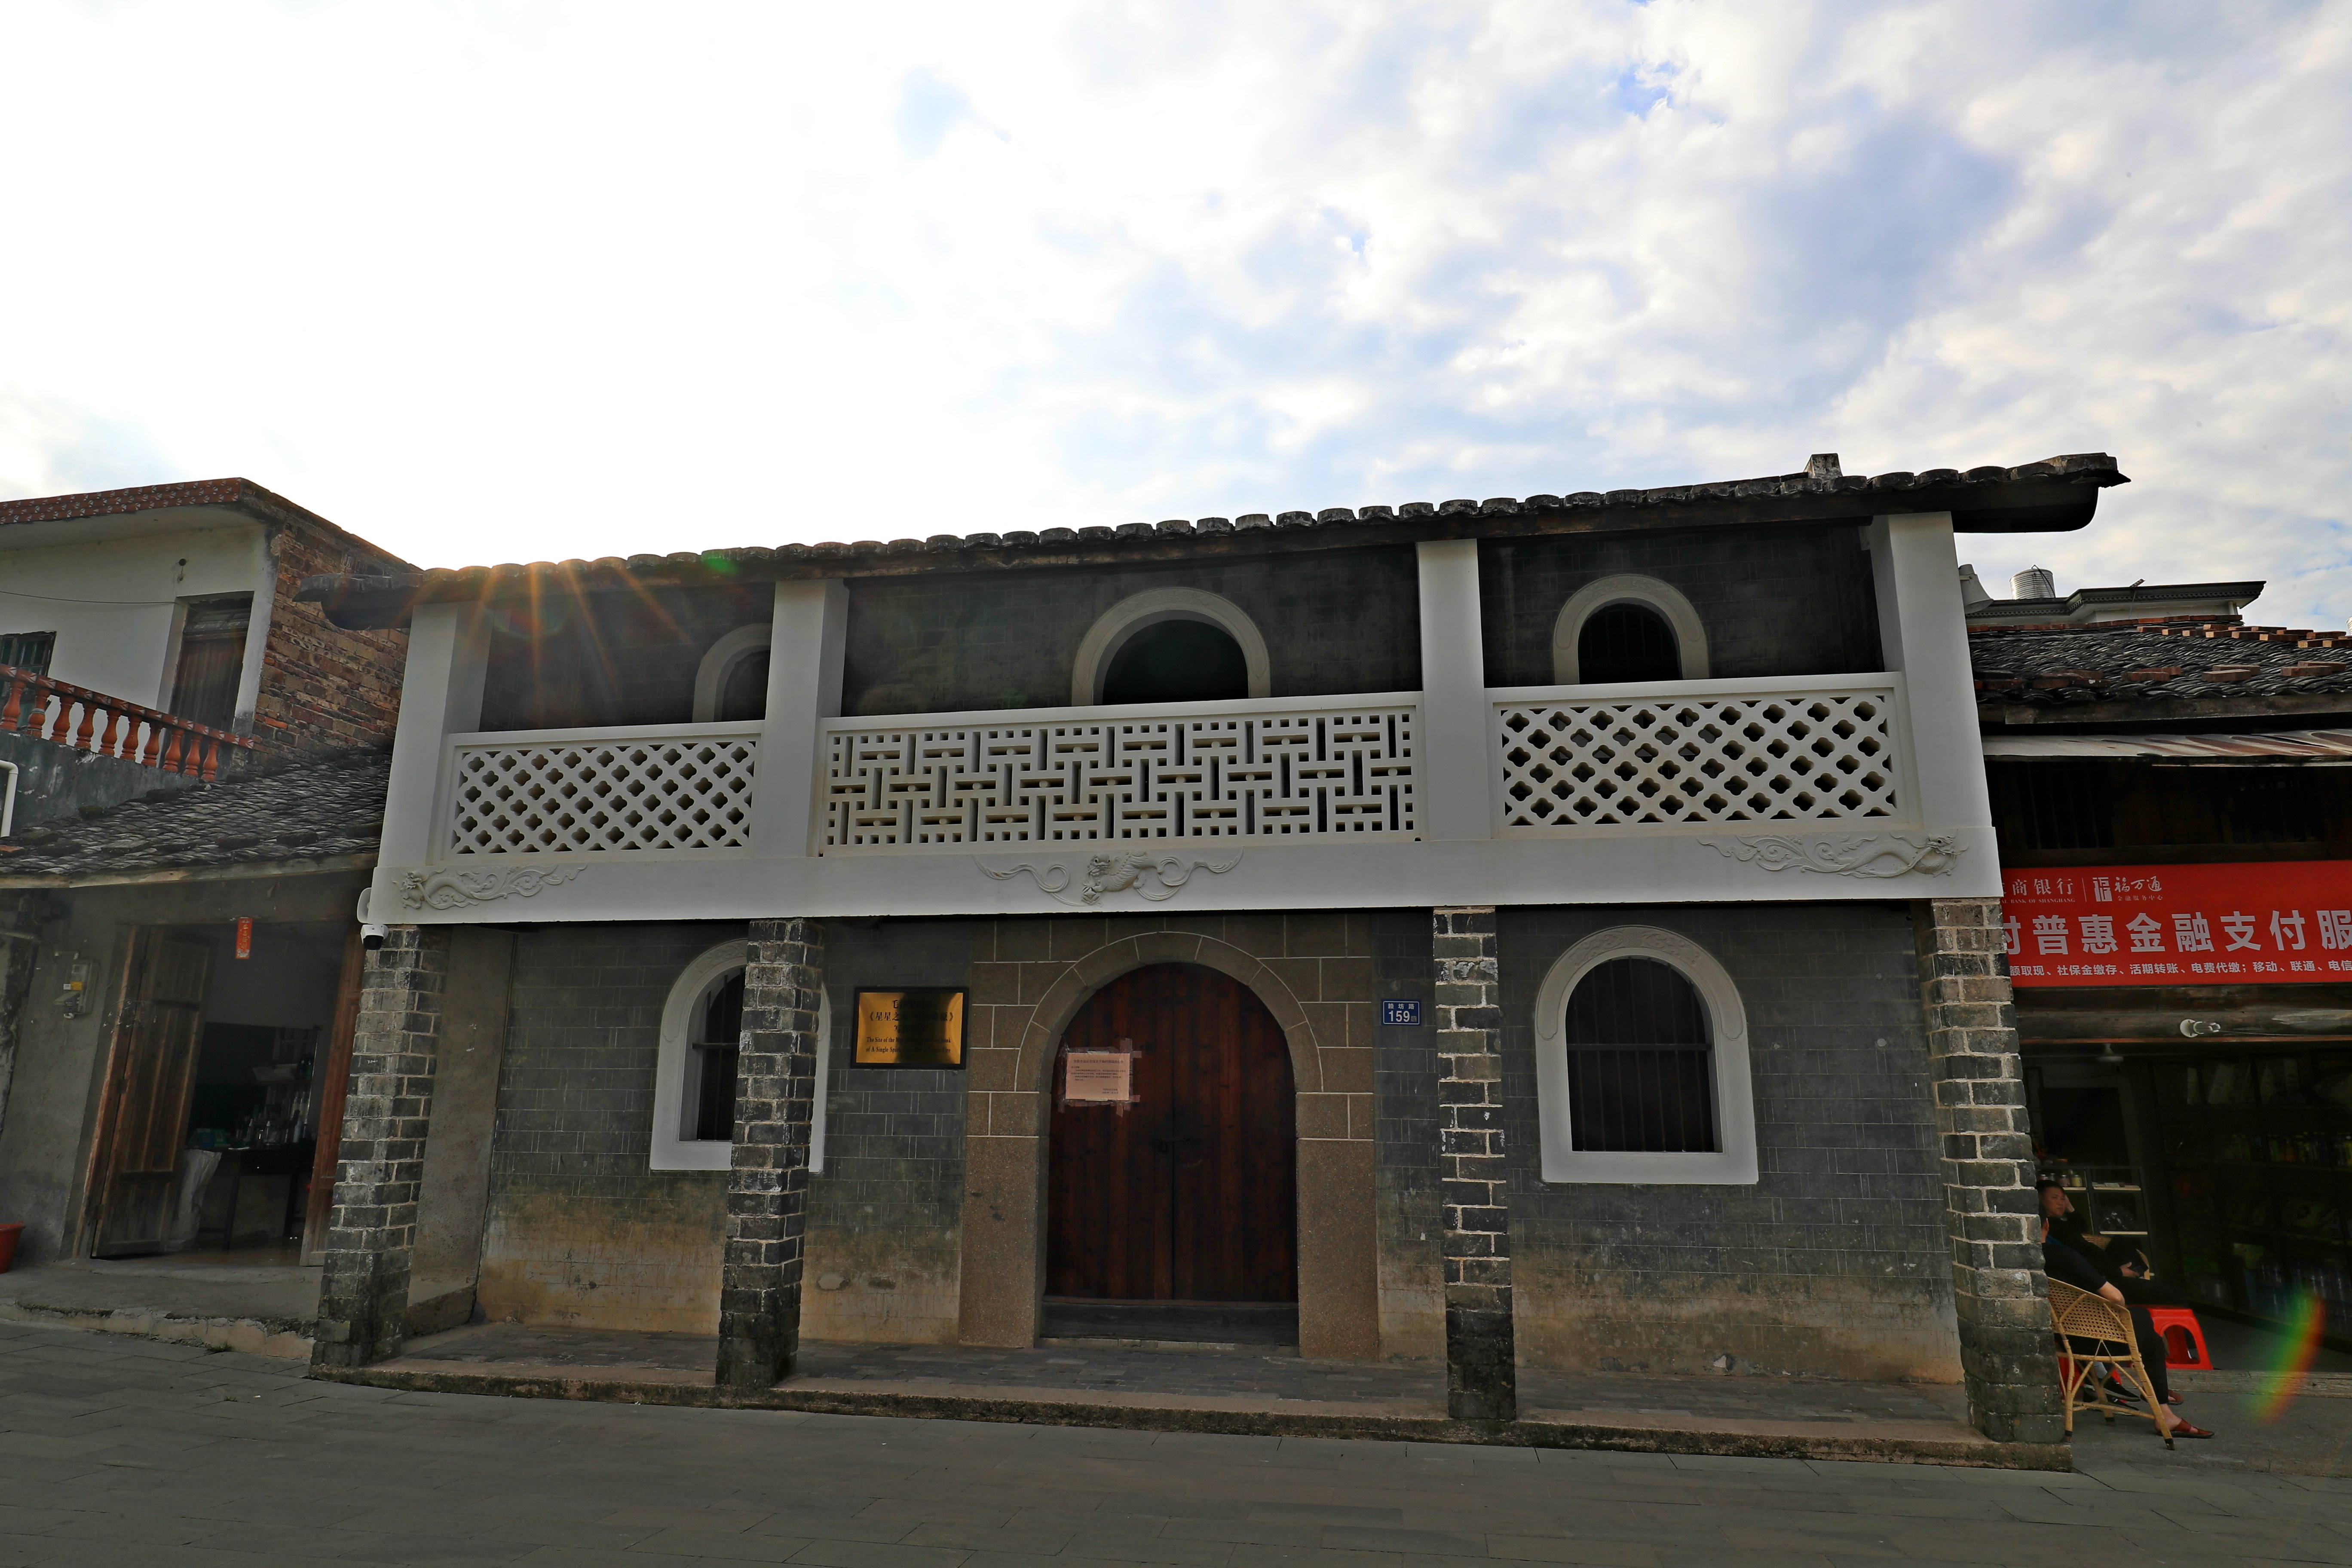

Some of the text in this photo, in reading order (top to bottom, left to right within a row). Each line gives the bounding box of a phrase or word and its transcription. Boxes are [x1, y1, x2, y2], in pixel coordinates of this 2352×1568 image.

[2003, 878, 2073, 896] 商银行
[2115, 876, 2162, 892] 福万通
[1389, 1011, 1410, 1022] 159
